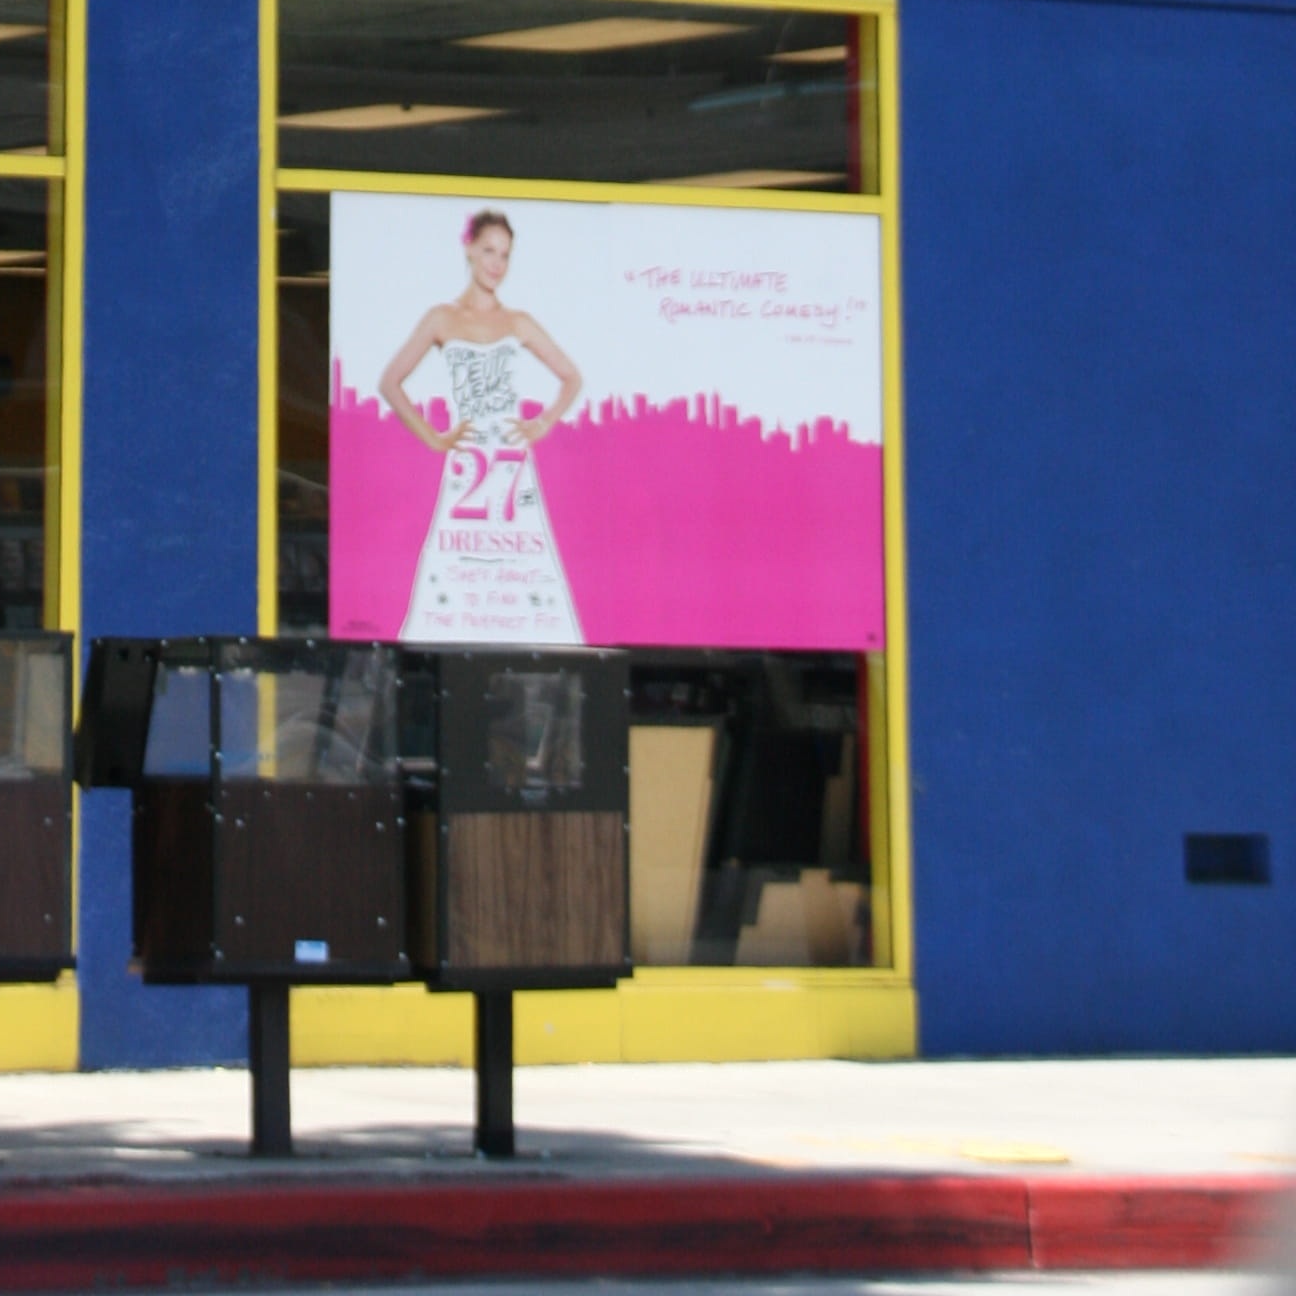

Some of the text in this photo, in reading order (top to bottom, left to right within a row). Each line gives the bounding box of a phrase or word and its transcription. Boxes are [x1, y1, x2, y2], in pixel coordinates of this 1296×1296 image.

[688, 269, 789, 293] ULTIMATE
[659, 295, 753, 325] ROMANTIC
[449, 445, 528, 523] 27
[438, 528, 546, 554] DRESSES
